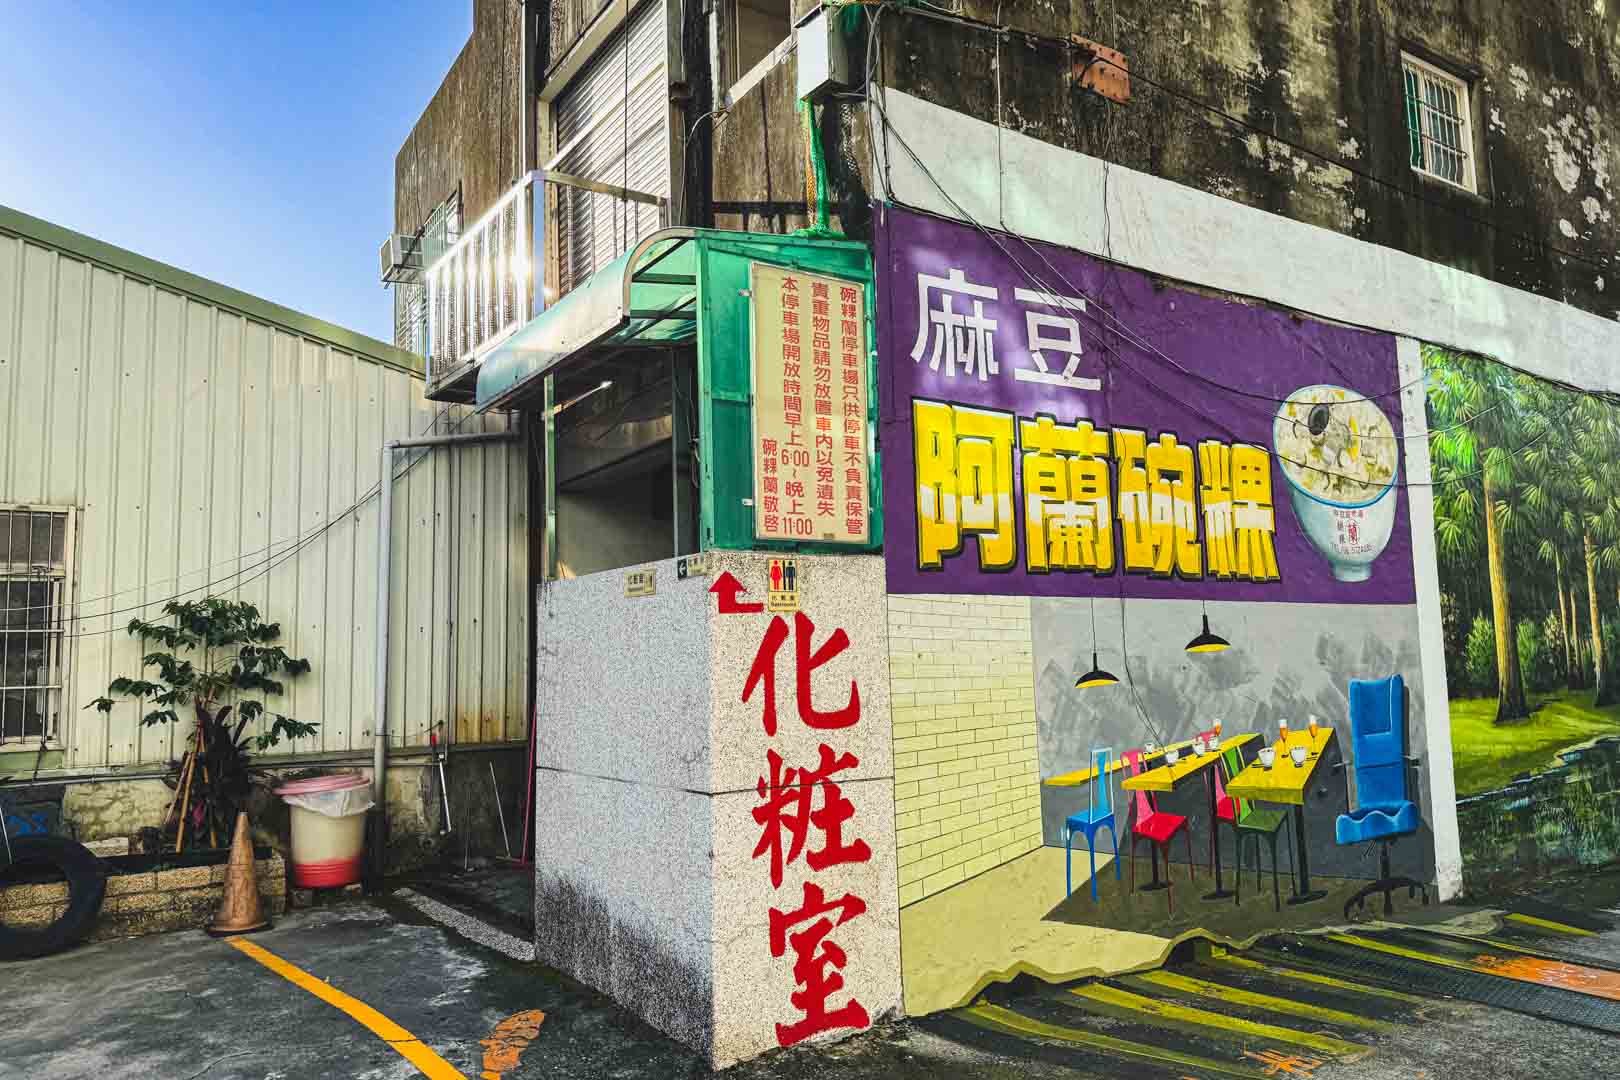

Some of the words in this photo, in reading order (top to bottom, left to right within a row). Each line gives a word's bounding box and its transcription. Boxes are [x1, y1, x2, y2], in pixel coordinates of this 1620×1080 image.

[811, 282, 835, 517] 貴重物品請勿放置車內以免遺失
[911, 268, 1101, 391] 麻豆
[912, 397, 1281, 583] 阿蘭碗粿
[741, 611, 872, 1048] 化粧室
